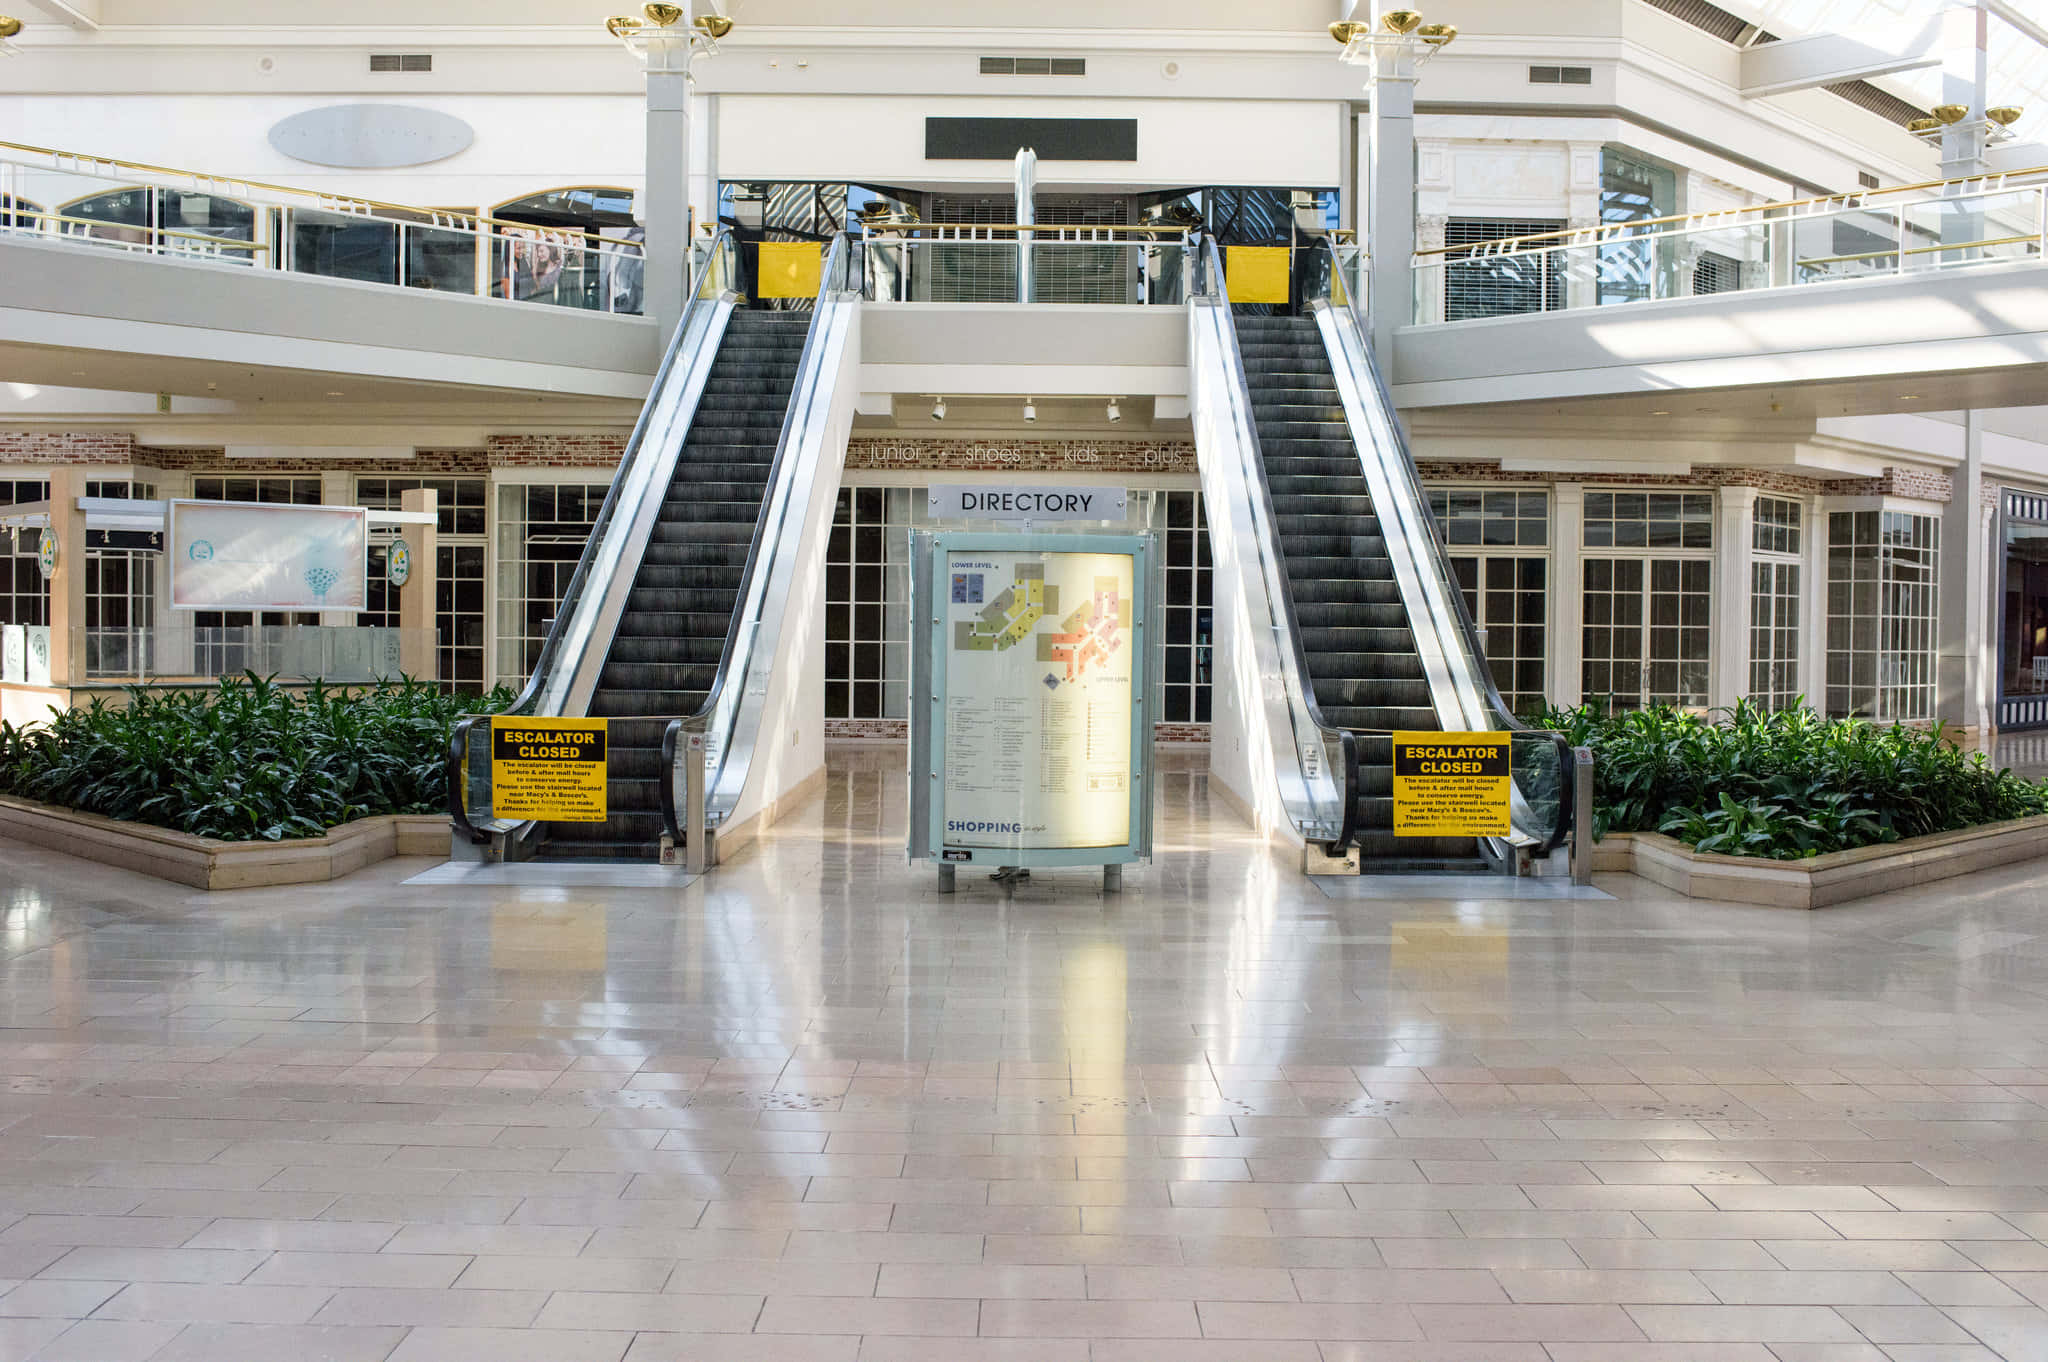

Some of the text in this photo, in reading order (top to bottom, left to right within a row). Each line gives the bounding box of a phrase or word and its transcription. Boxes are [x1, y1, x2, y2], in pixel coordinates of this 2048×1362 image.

[870, 444, 1183, 465] junior shoes kids plus
[962, 492, 1093, 512] DIRECTORY
[504, 731, 595, 744] ESCALATOR
[519, 746, 580, 758] CLOSED
[1405, 747, 1498, 759] ESCALATOR
[1420, 762, 1482, 773] CLOSED
[948, 820, 1021, 833] SHOPPING
